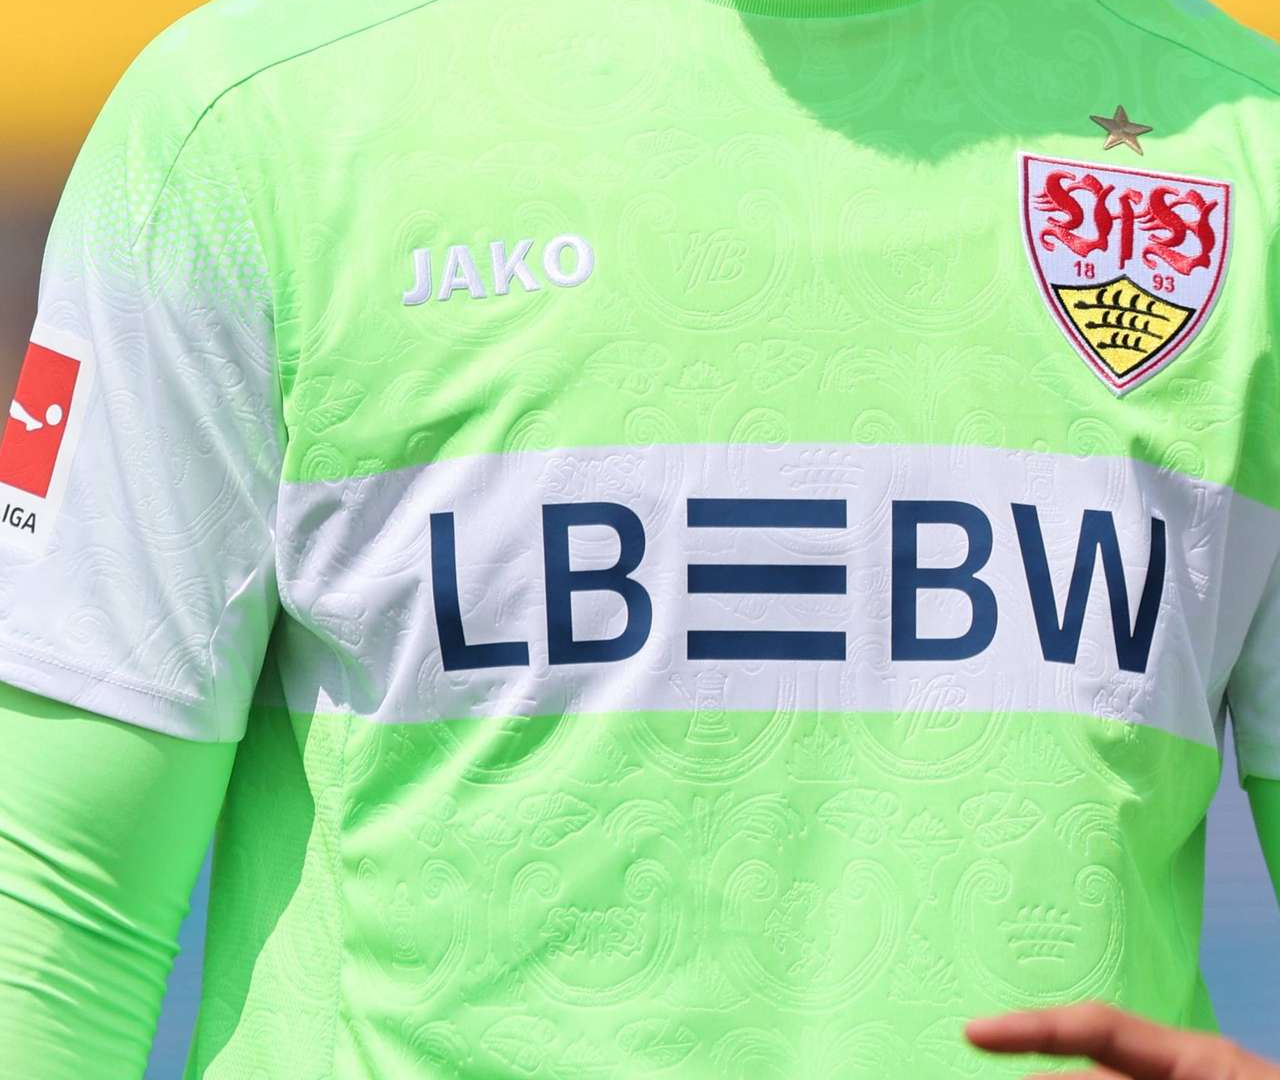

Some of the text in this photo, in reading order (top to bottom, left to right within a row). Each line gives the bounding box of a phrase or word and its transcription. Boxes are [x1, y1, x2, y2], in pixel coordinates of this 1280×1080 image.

[402, 232, 595, 306] JAKO
[1073, 260, 1175, 293] 18 93
